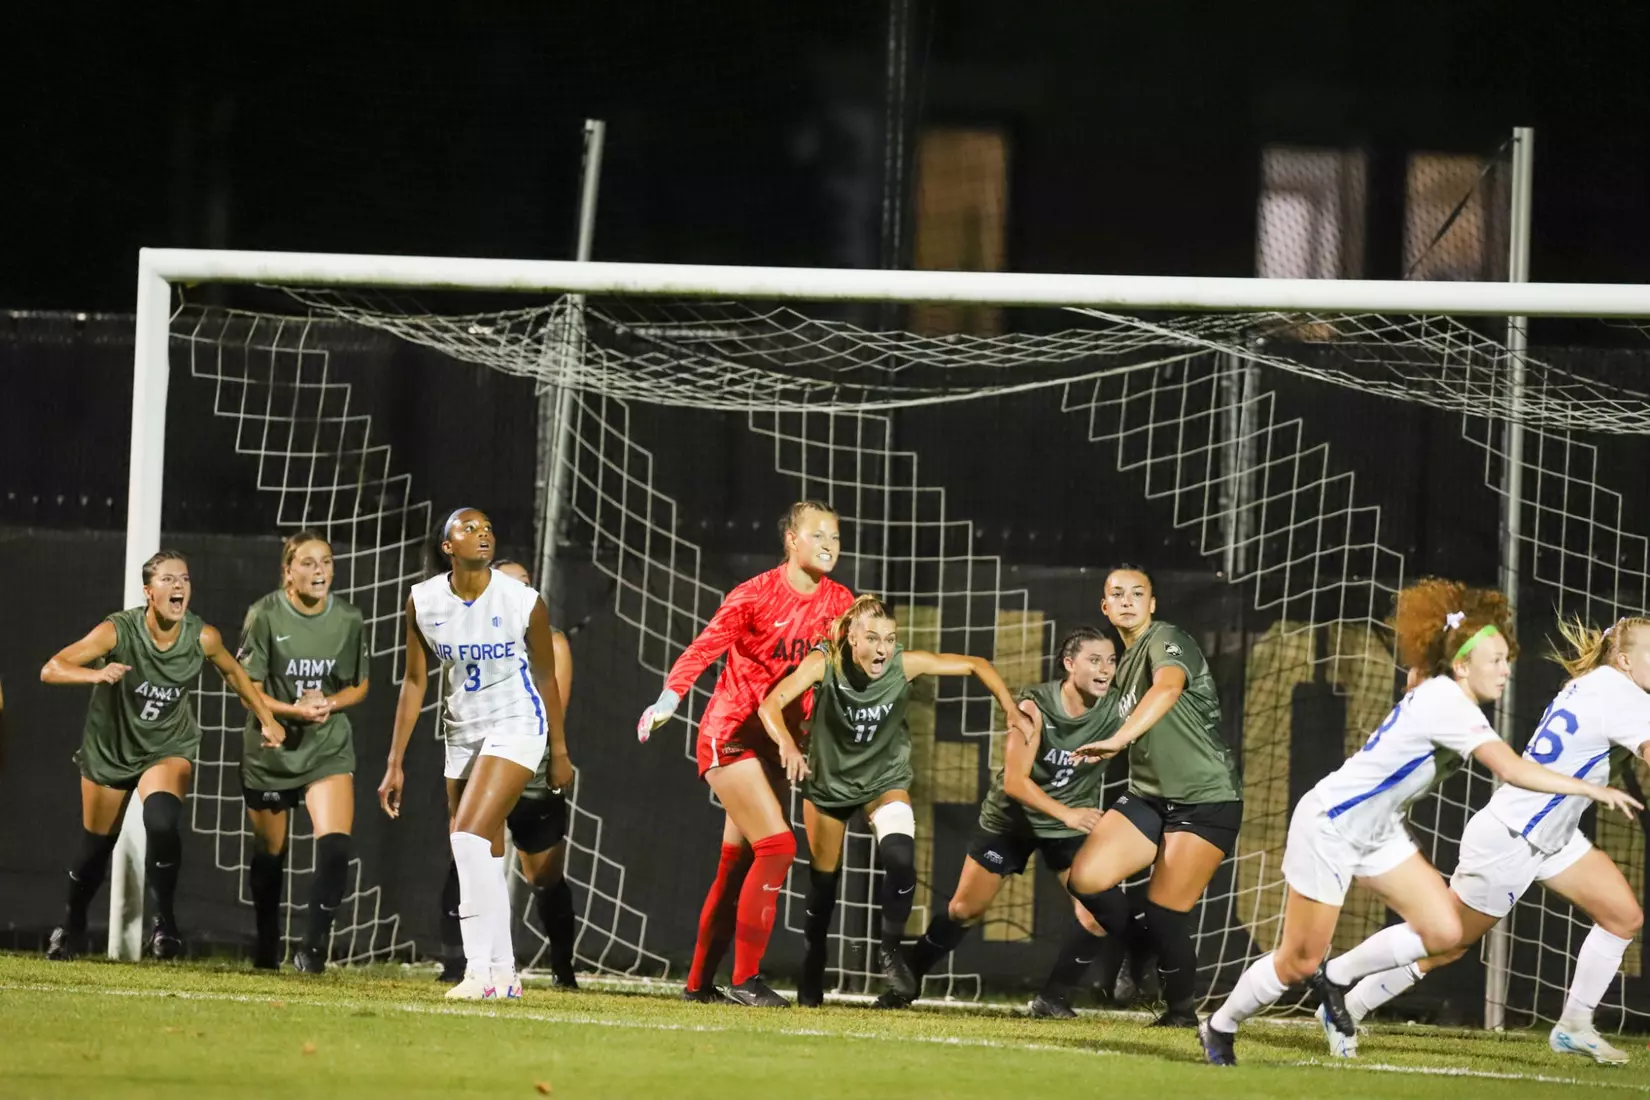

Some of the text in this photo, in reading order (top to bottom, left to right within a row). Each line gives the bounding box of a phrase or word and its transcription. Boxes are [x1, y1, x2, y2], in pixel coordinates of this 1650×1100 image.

[458, 641, 516, 661] FORCE
[772, 637, 822, 662] AR
[285, 658, 336, 677] ARMY
[464, 663, 481, 692] 3
[140, 700, 164, 721] 6
[854, 724, 878, 743] 11
[1043, 748, 1090, 767] AR
